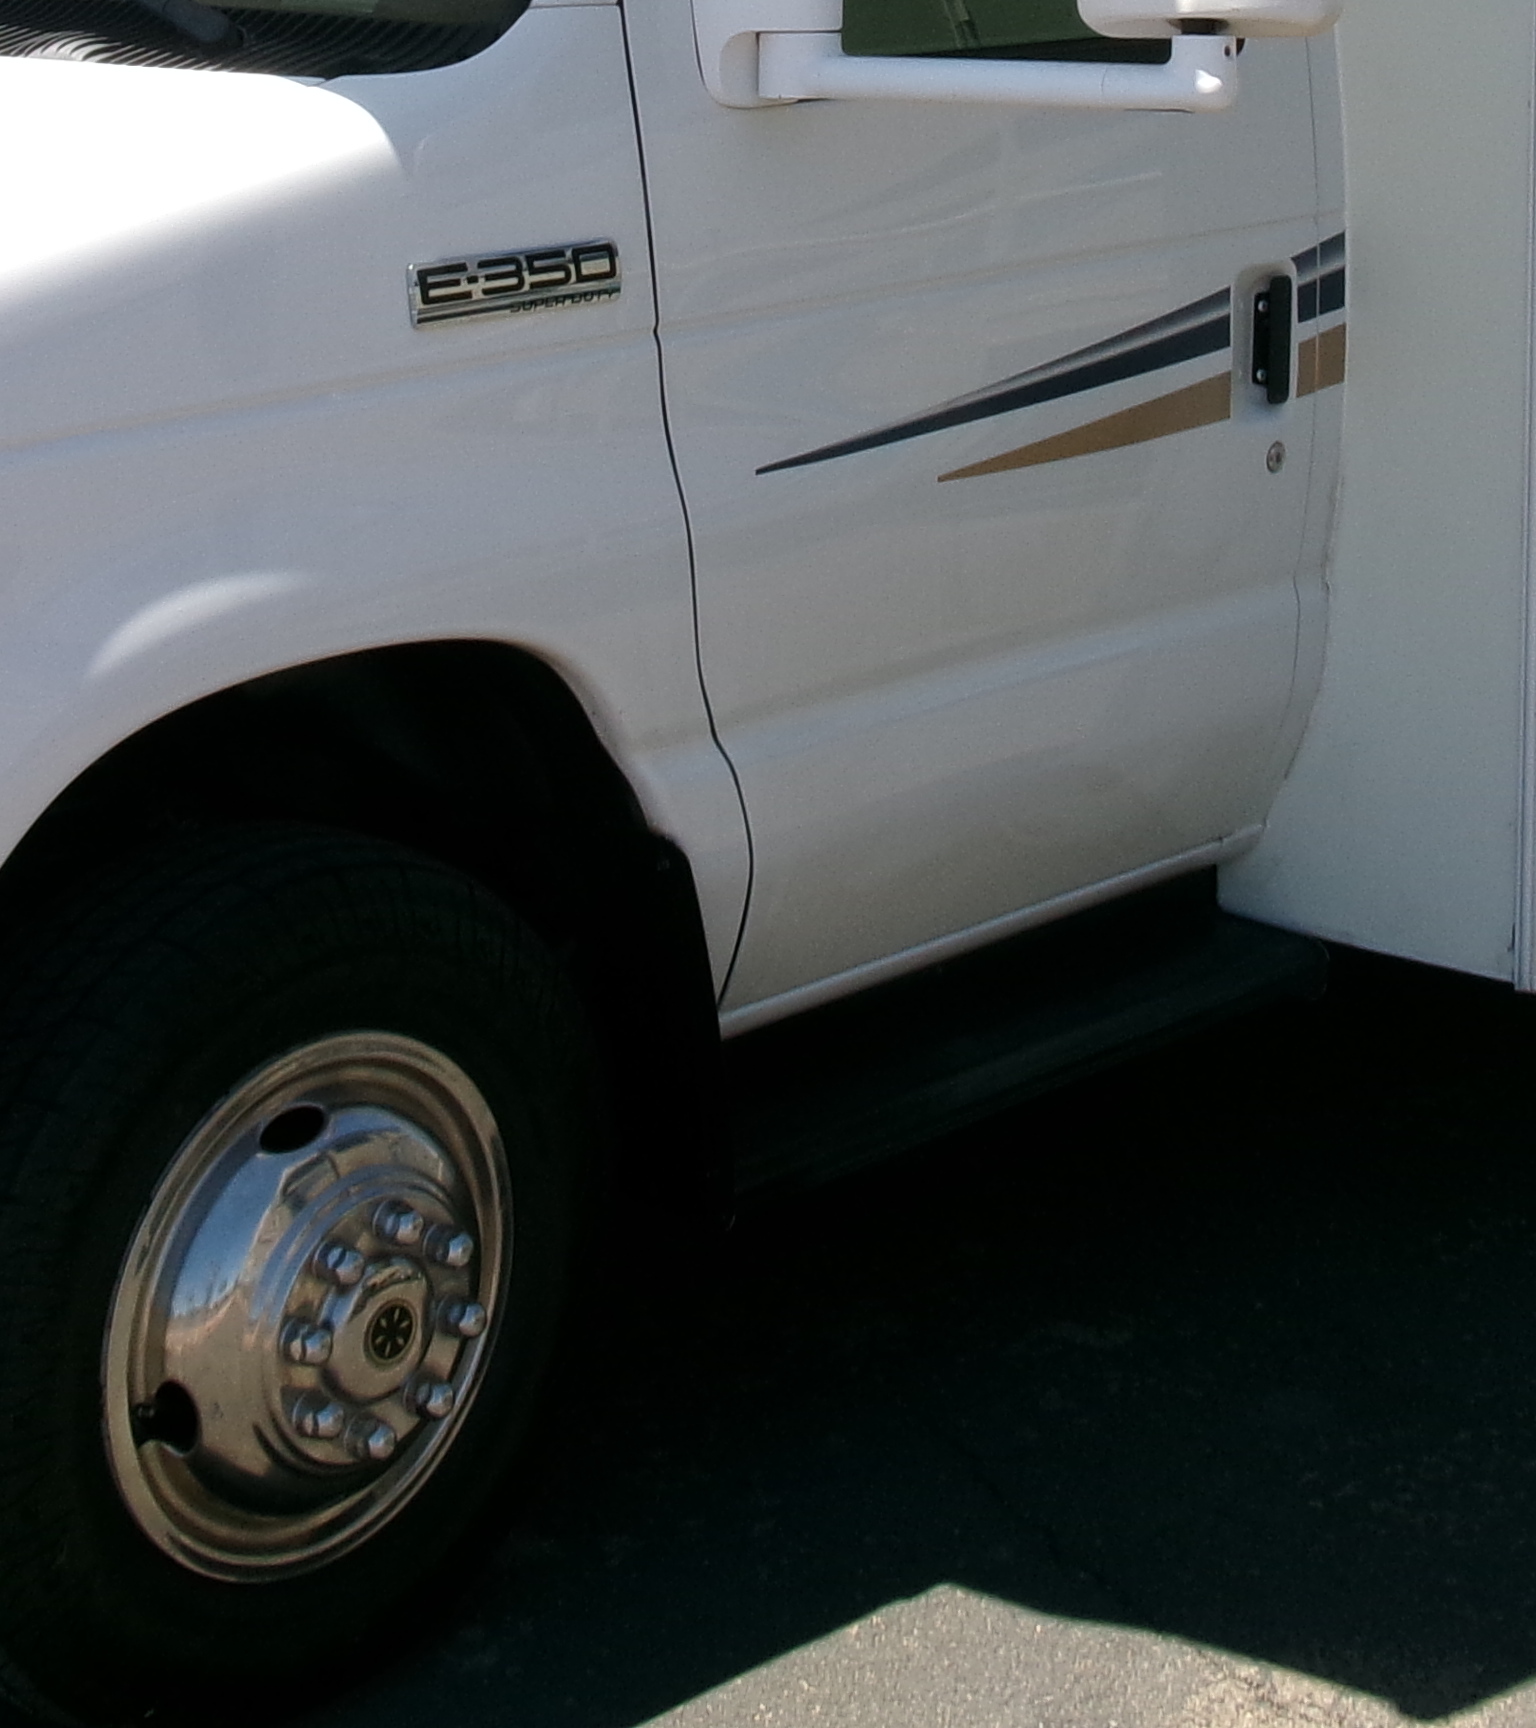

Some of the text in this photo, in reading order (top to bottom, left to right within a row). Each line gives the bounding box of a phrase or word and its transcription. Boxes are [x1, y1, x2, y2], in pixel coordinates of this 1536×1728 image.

[416, 242, 617, 306] E-350
[510, 288, 615, 313] SUPER DUTY
